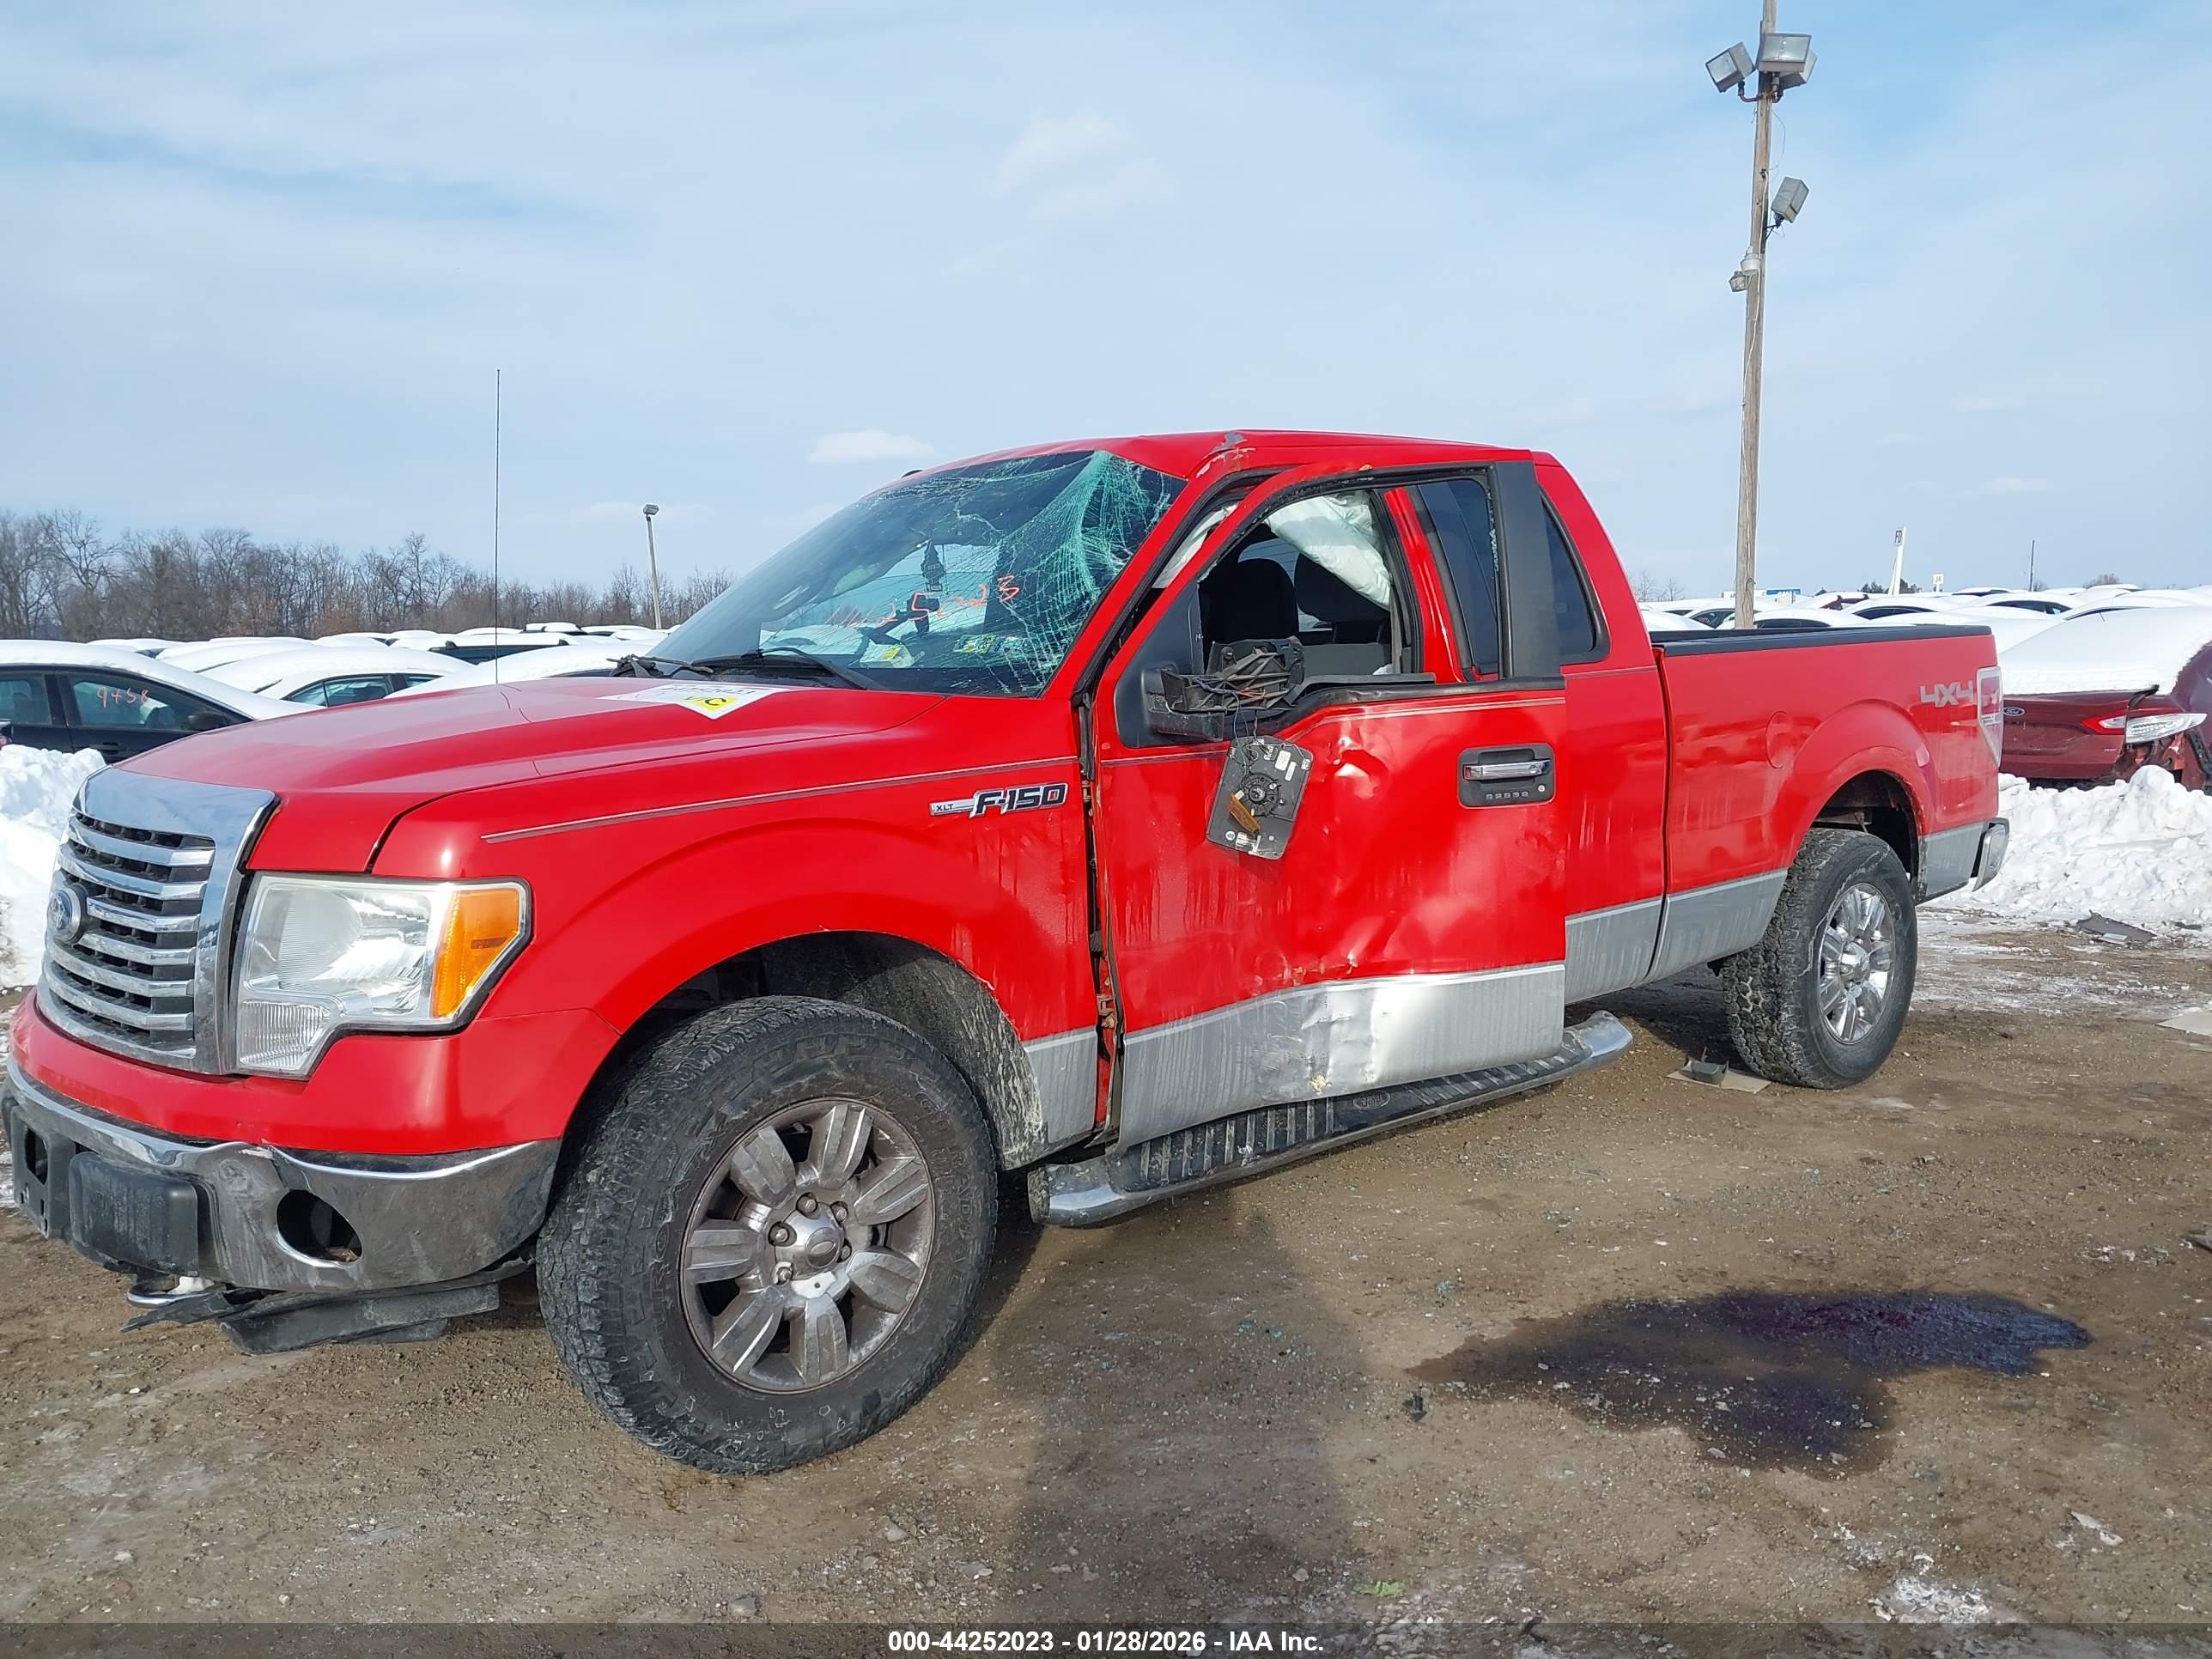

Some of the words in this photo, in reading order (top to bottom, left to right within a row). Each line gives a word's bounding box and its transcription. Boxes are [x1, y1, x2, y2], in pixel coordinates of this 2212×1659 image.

[1920, 680, 1974, 708] 4X4
[935, 803, 955, 812] XLT
[973, 782, 1069, 817] F-150
